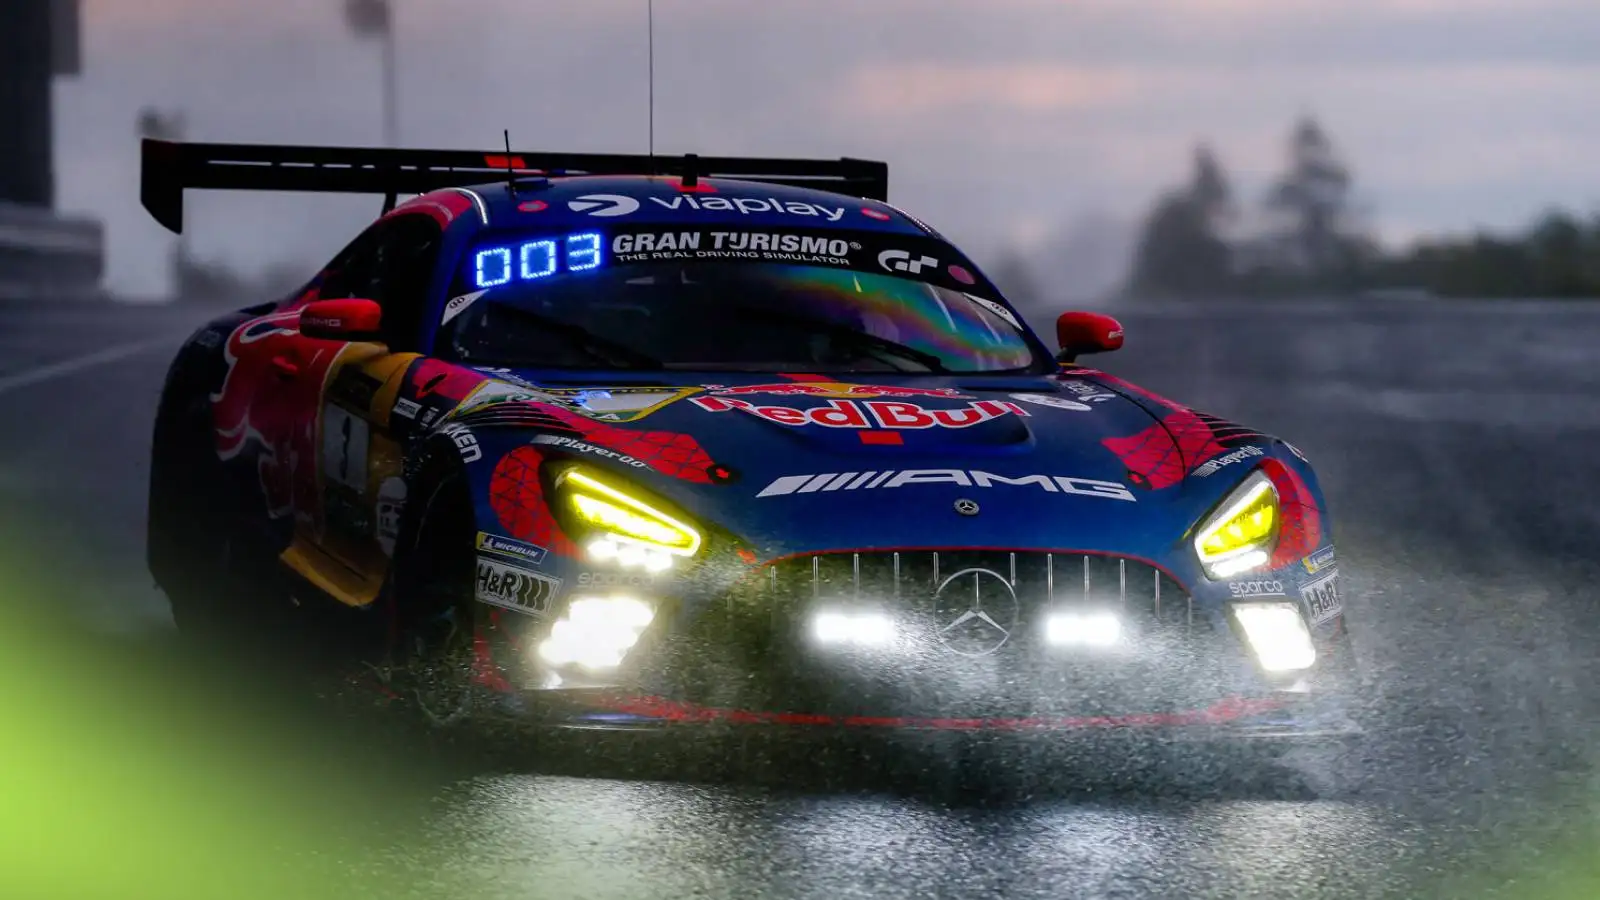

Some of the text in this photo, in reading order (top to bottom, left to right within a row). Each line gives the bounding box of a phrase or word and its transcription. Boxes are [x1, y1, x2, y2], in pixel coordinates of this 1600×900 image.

[650, 194, 845, 221] viaplay
[612, 231, 701, 253] GRAN
[476, 233, 600, 287] 003
[616, 250, 850, 266] THE REAL DRIVING SIMULATOR
[877, 249, 939, 274] GT
[686, 395, 872, 428] Red
[862, 399, 1032, 429] Bull
[885, 469, 1137, 501] AMG
[494, 541, 539, 557] MICHELIN
[477, 563, 517, 599] H&R
[577, 572, 655, 588] sparco
[1229, 580, 1283, 597] sparco
